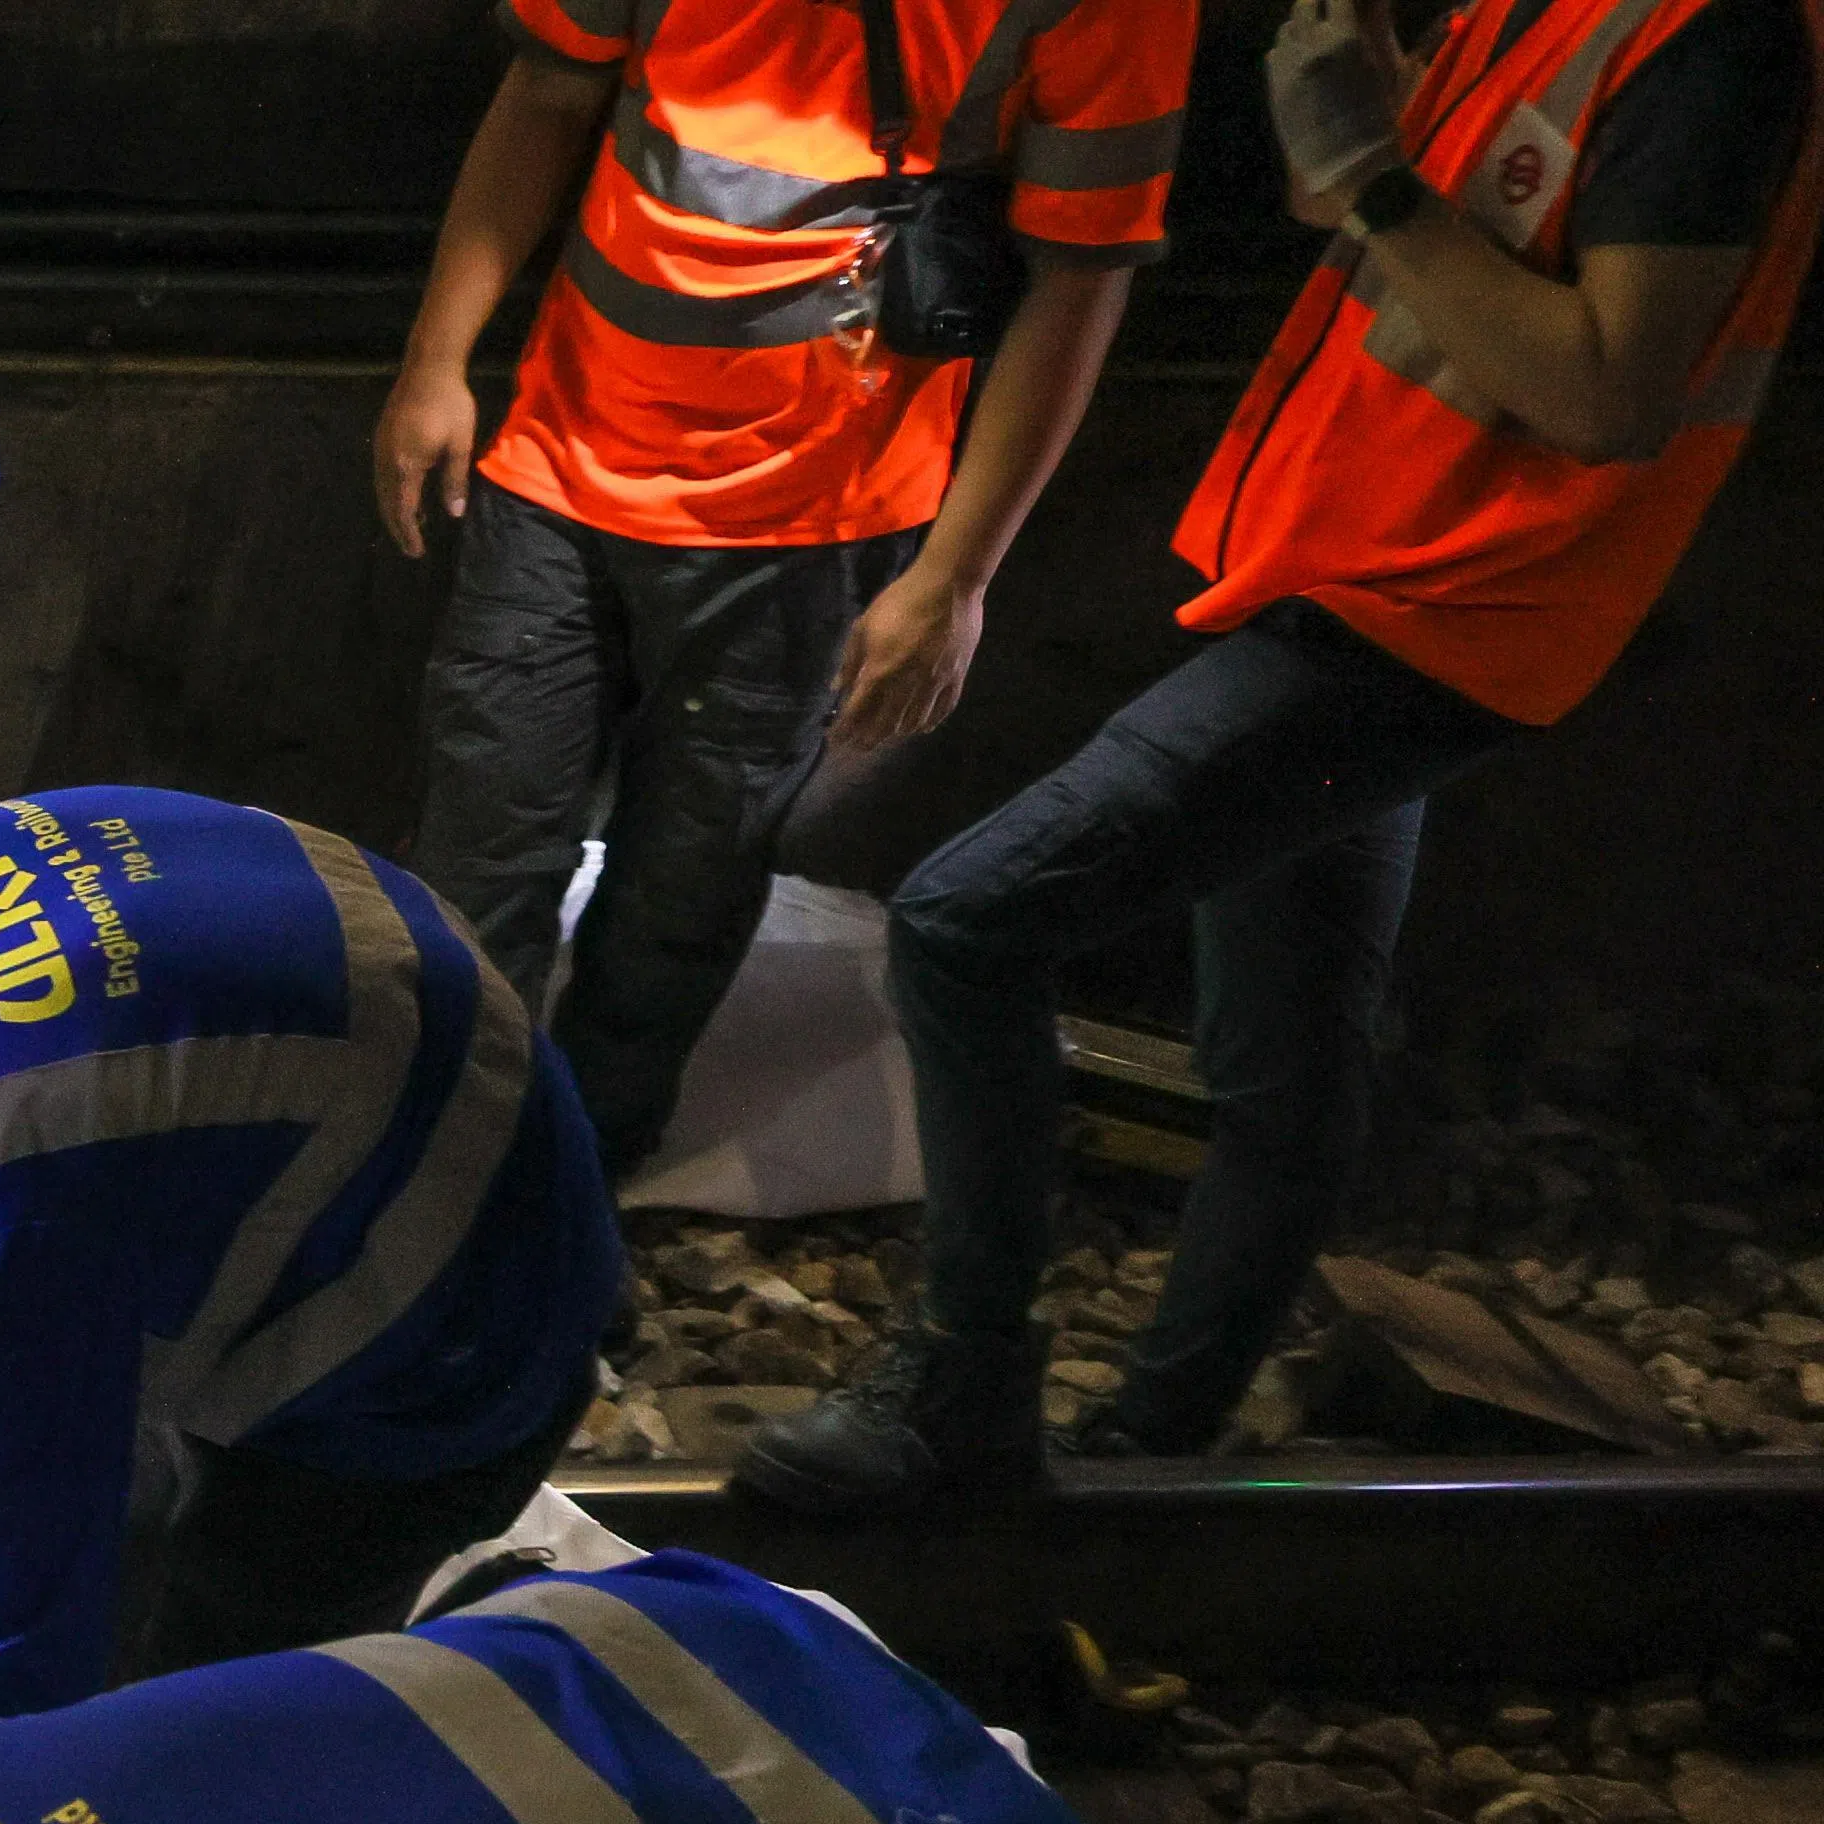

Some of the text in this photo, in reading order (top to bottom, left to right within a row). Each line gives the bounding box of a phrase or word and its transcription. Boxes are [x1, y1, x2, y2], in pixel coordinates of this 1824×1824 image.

[48, 848, 81, 866] &
[88, 818, 162, 882] Pte Ltd
[63, 864, 141, 998] Engineering
